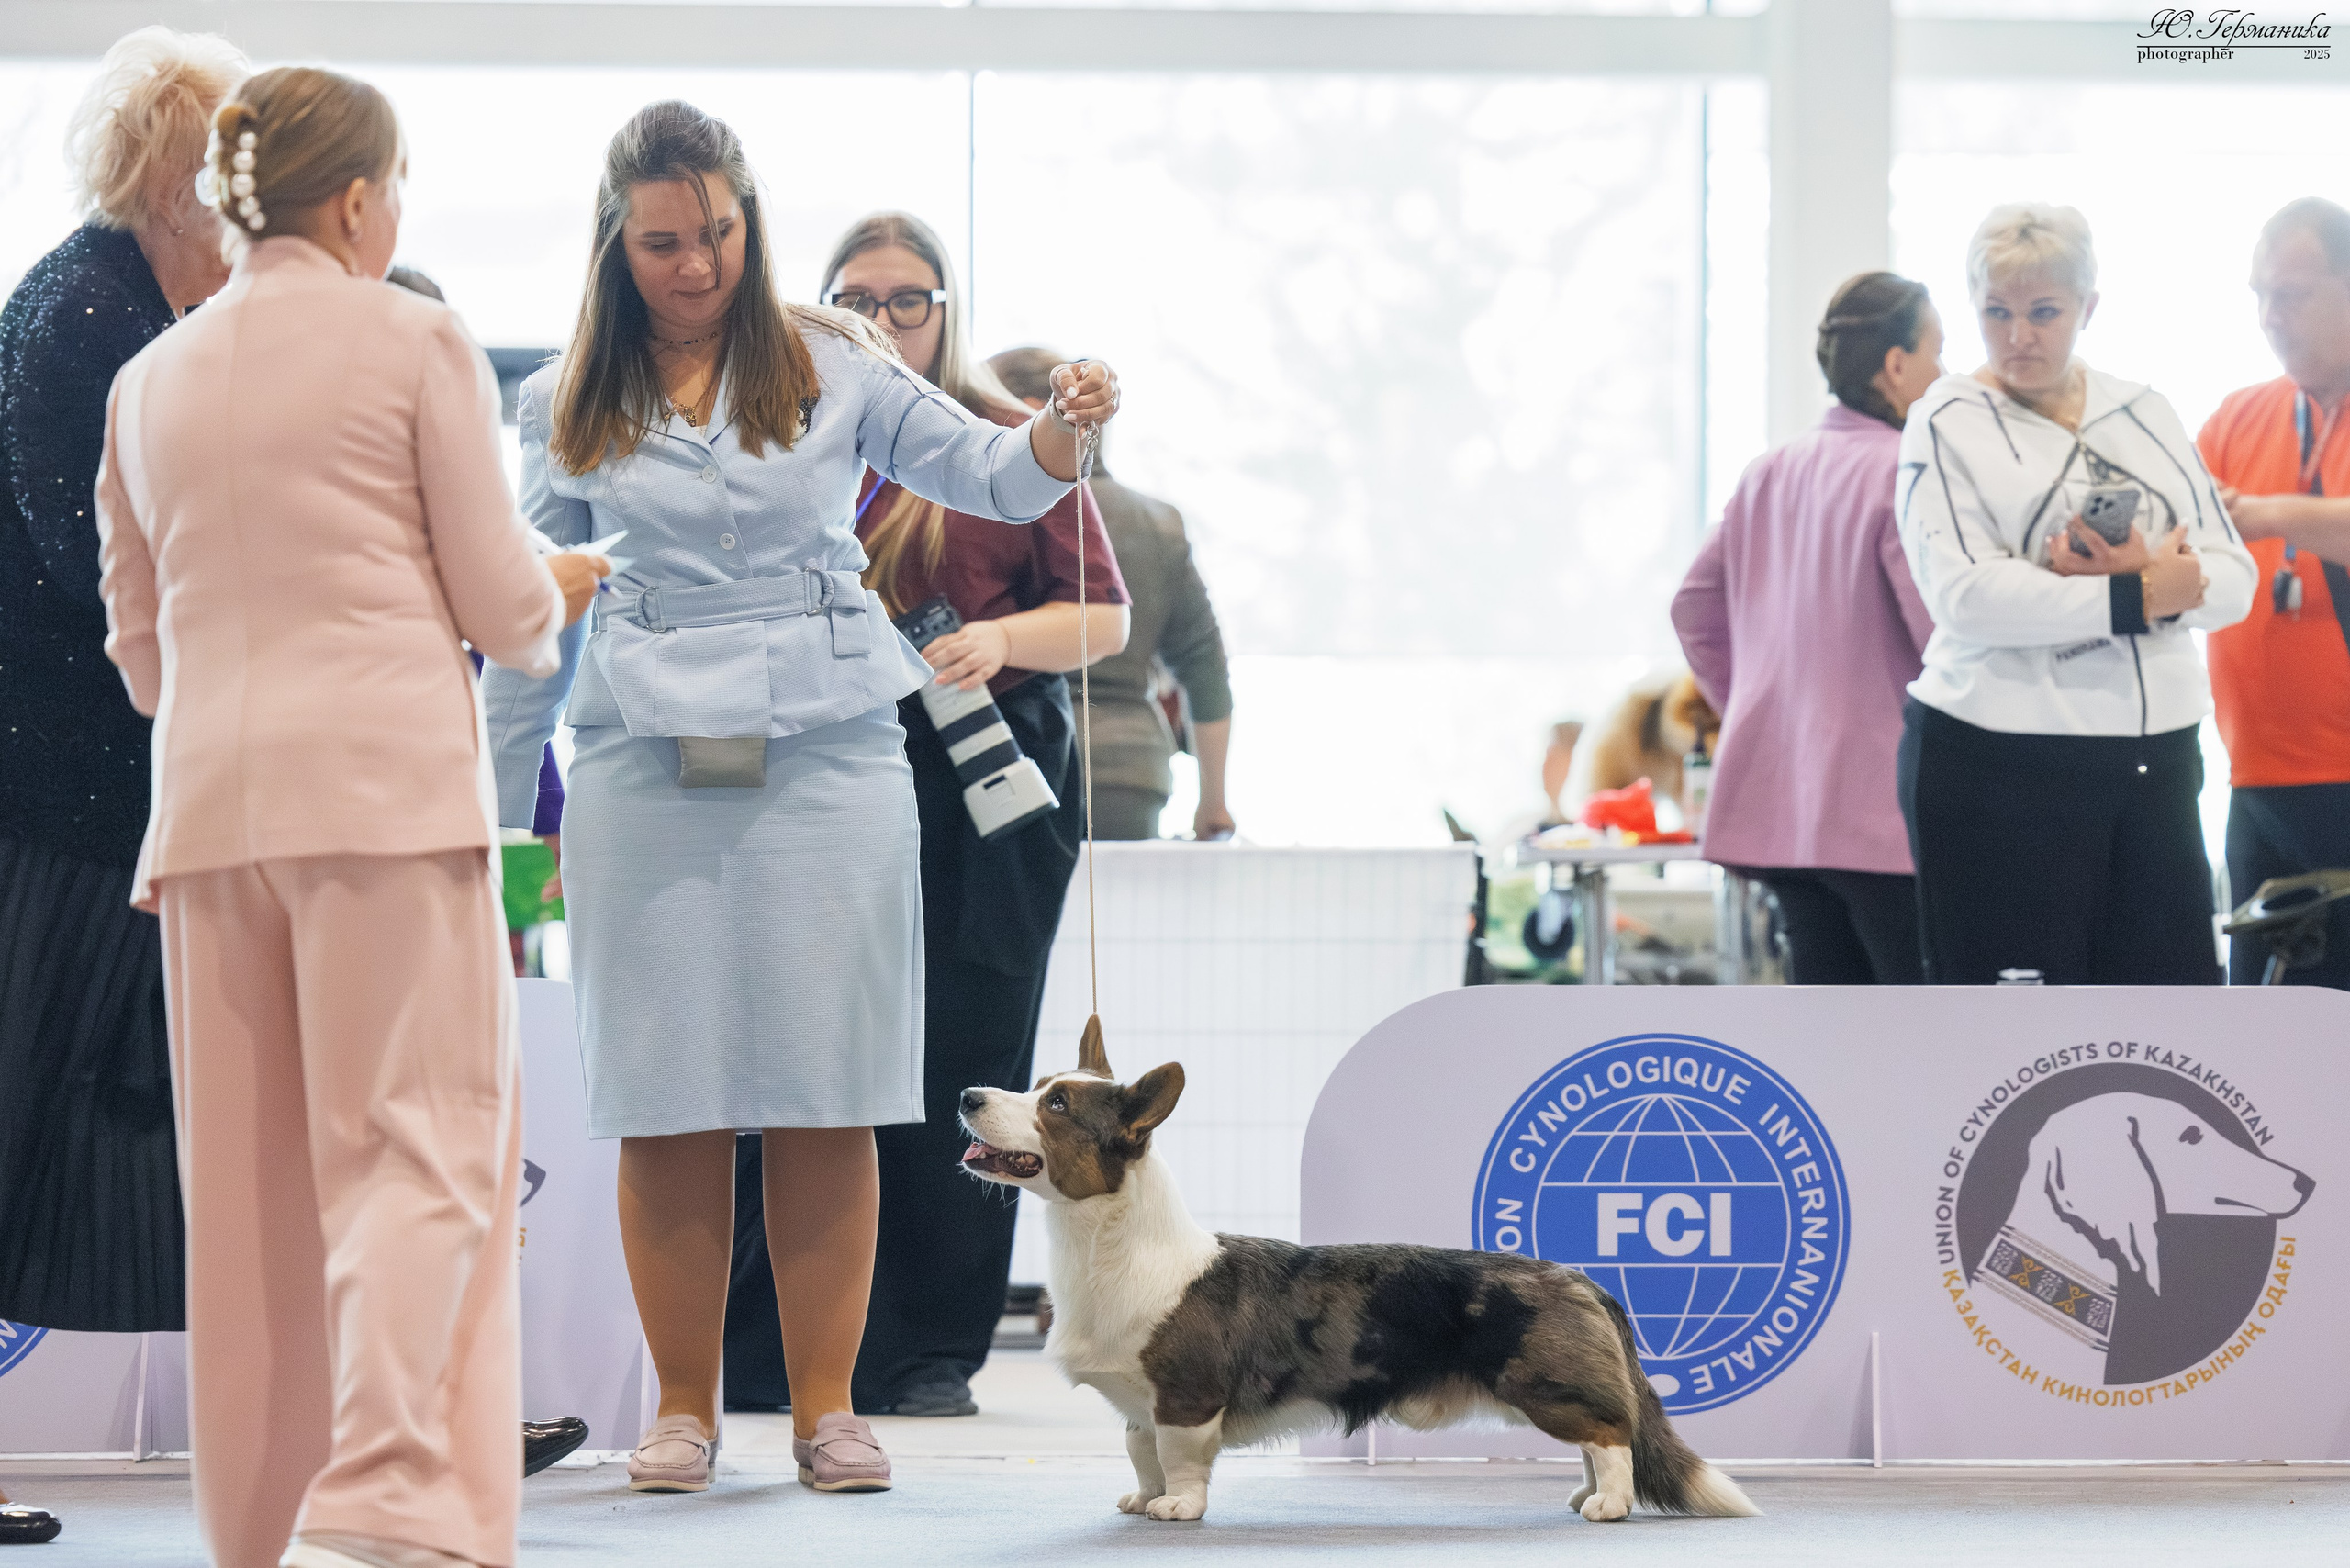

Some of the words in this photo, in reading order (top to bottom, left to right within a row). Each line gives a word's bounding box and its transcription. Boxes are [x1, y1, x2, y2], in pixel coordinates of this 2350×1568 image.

[1959, 1042, 2098, 1143] CYNOLOGISTS
[2107, 1041, 2139, 1058] OF
[1509, 1055, 1751, 1173] CYNOLOGIQUE
[2144, 1045, 2275, 1146] KAZAKHSTAN
[1943, 1146, 1964, 1178] OF
[1597, 1193, 1732, 1257] FCI
[1936, 1186, 1955, 1265] UNION
[1943, 1269, 2039, 1385] ҚАЗАҚСТАН
[2042, 1322, 2266, 1407] КИНОЛОГТАРЫНЫҢ
[2258, 1236, 2296, 1319] ОДАҒЫ
